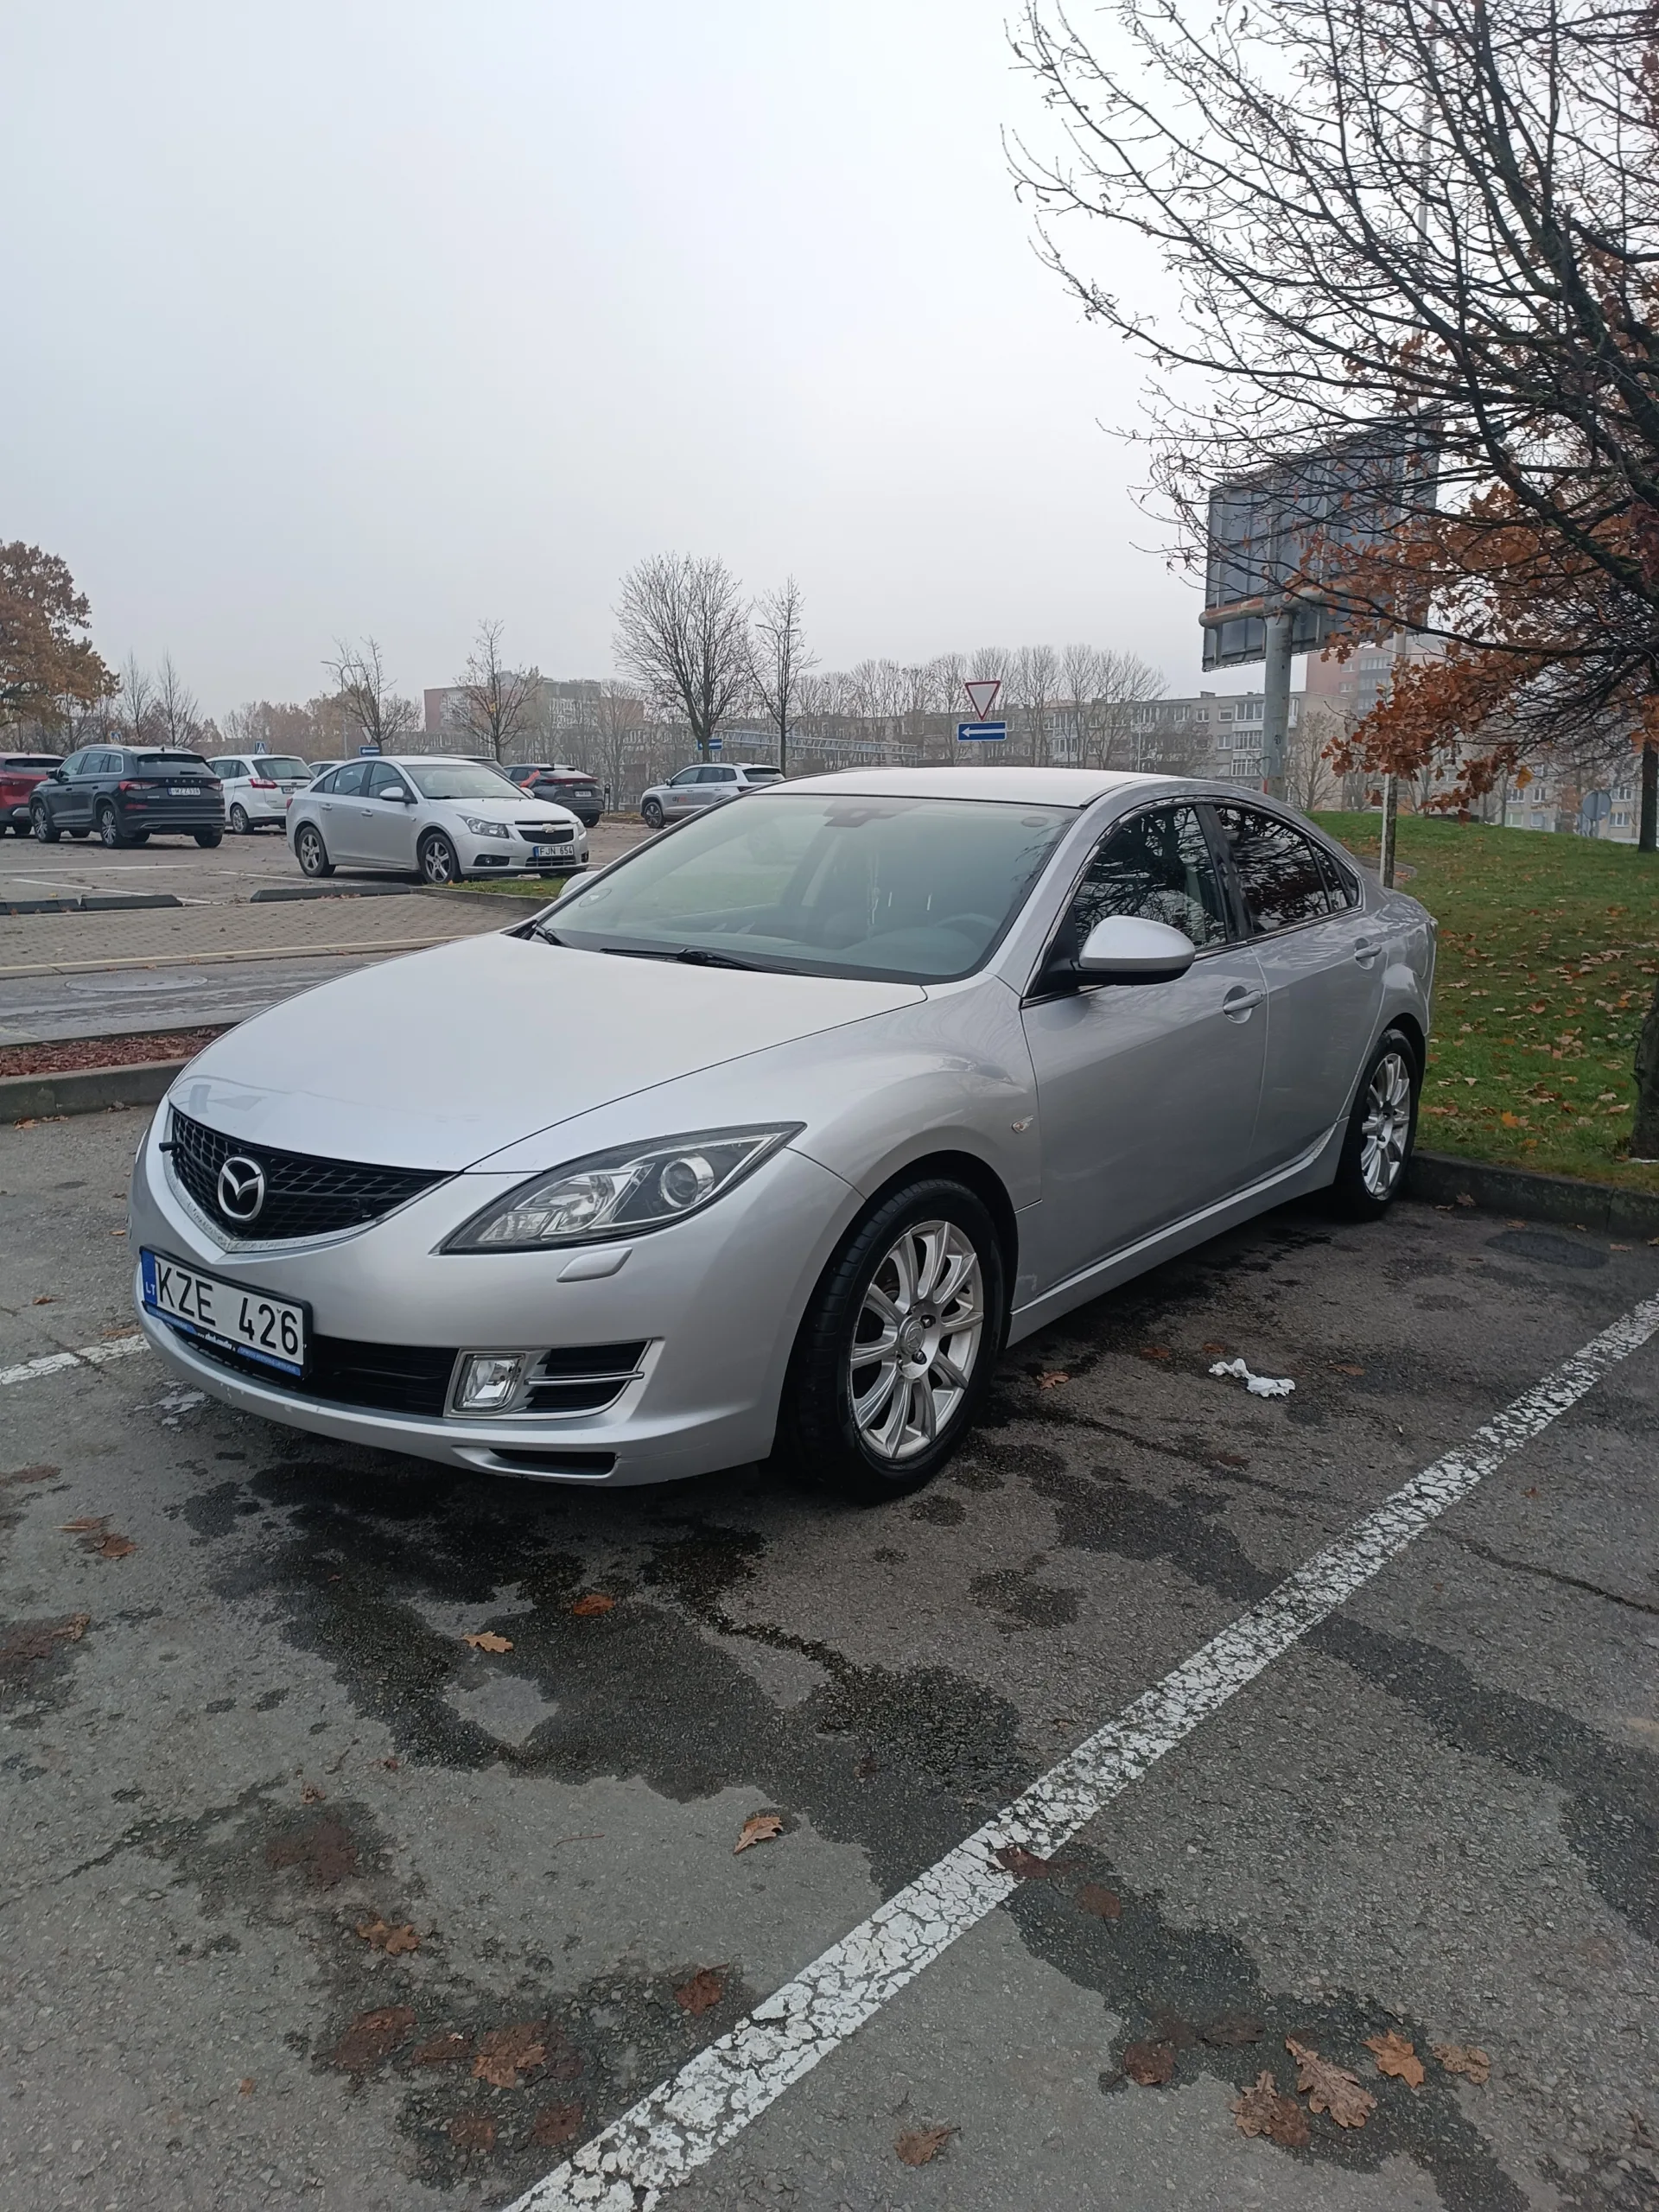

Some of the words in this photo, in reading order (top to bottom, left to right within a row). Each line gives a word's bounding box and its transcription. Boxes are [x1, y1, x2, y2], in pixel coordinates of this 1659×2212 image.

[145, 1281, 156, 1296] LT
[156, 1261, 216, 1327] KZE
[238, 1296, 298, 1356] 426
